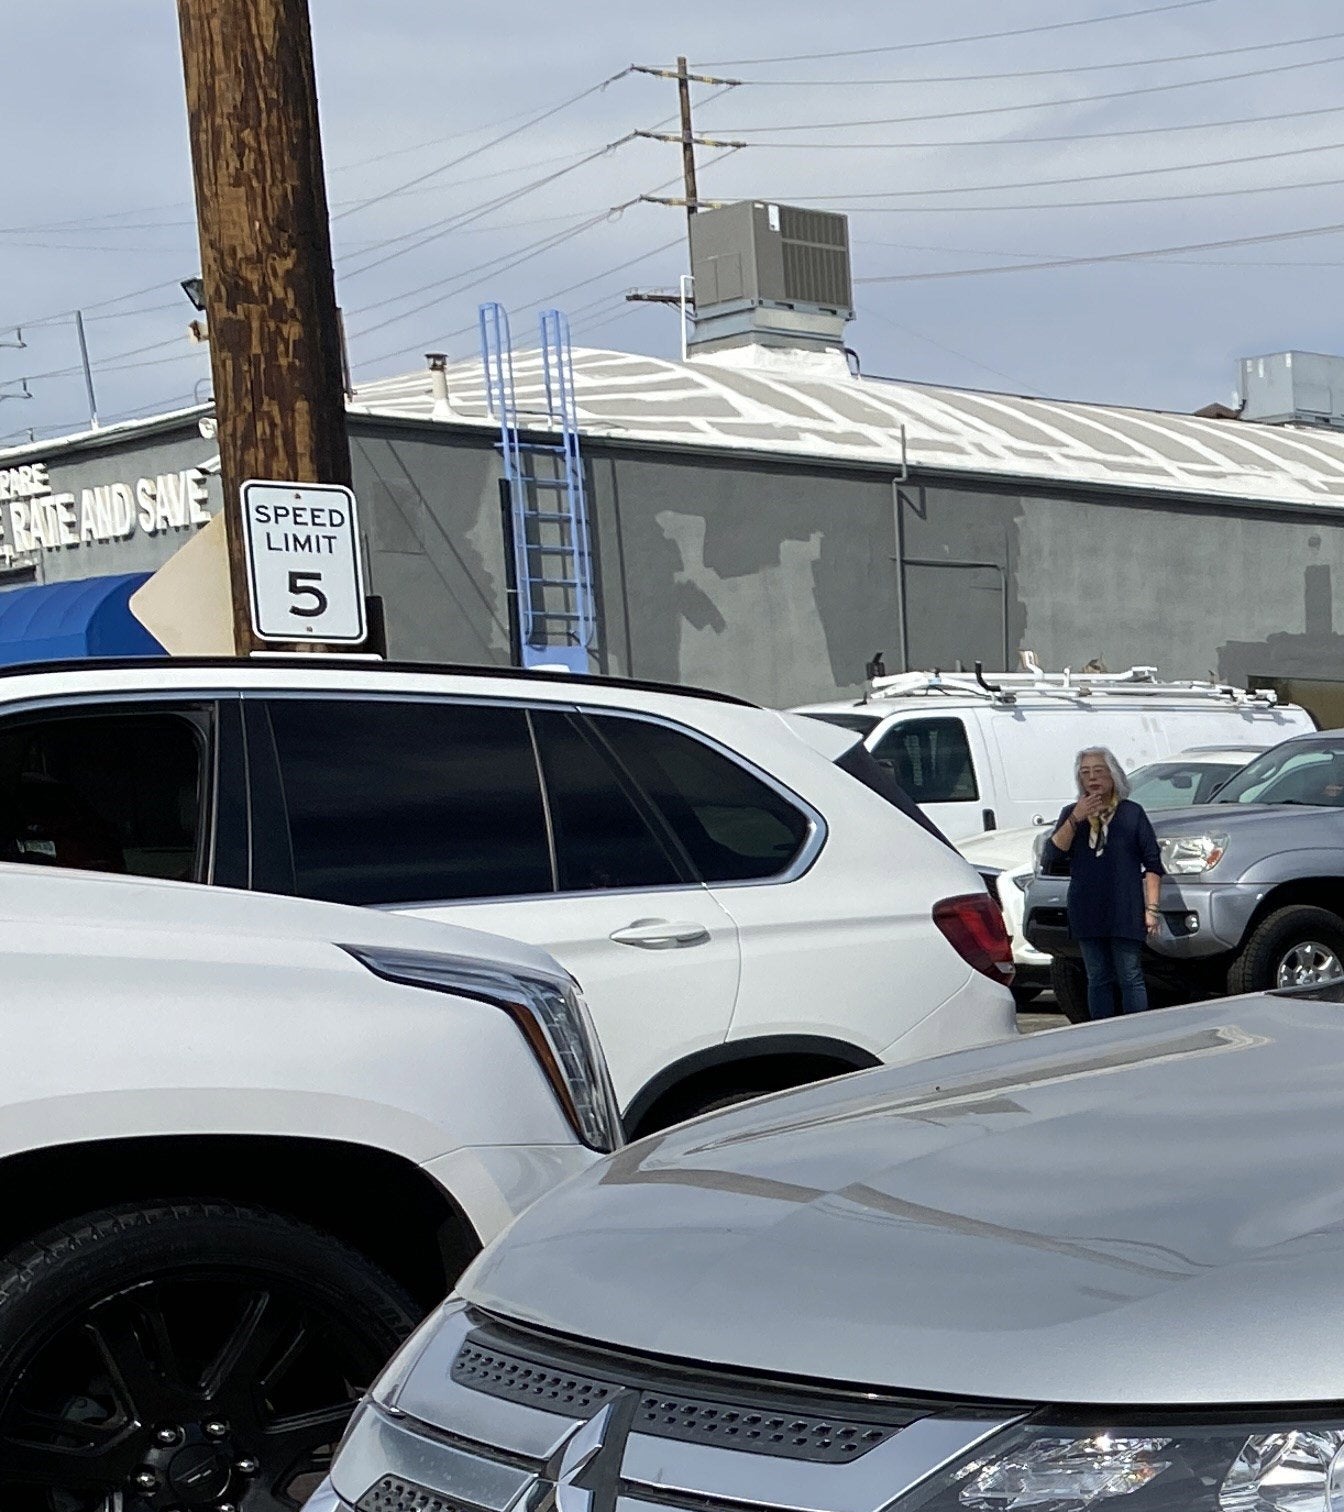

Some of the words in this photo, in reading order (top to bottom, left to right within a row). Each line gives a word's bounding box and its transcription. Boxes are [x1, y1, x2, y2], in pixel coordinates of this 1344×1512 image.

[9, 493, 80, 553] RATE
[81, 483, 136, 541] AND
[137, 469, 211, 533] SAVE
[254, 504, 345, 528] SPEED
[266, 531, 338, 554] LIMIT
[288, 571, 329, 618] 5
